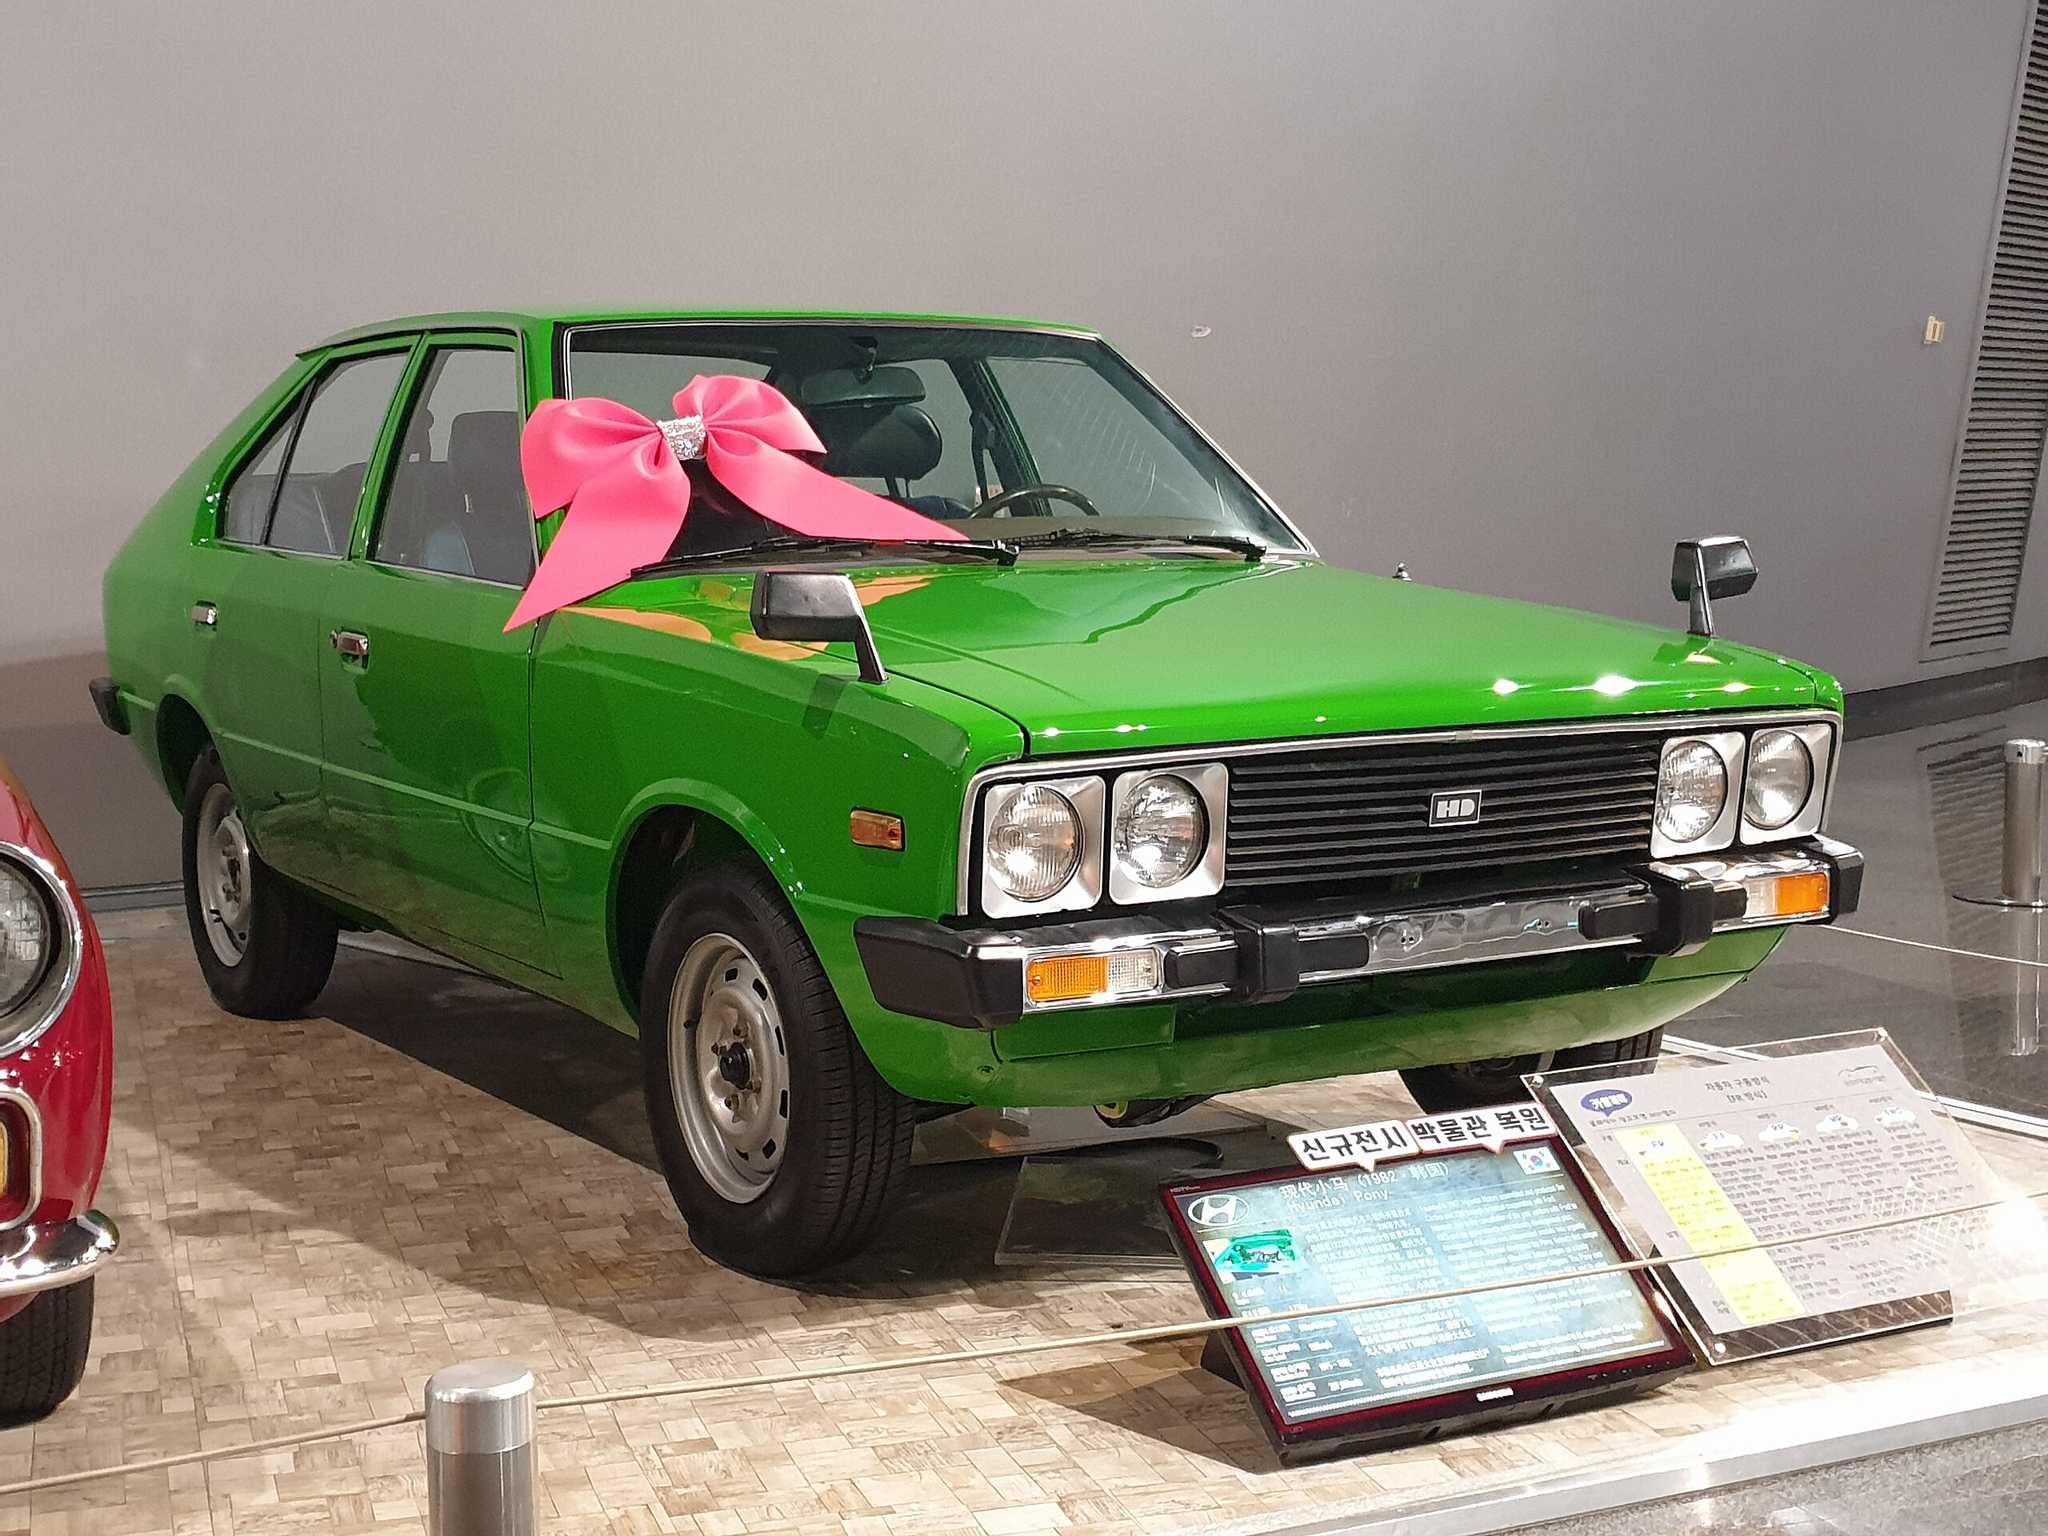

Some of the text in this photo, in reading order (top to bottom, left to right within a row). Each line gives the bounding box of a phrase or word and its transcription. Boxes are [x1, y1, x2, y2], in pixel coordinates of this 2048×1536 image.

[1436, 798, 1475, 818] HD
[1412, 1107, 1551, 1145] 박물관 복원
[1302, 1126, 1408, 1162] 신규전시
[1279, 1177, 1349, 1201] 现代小马
[1353, 1188, 1390, 1203] Pony
